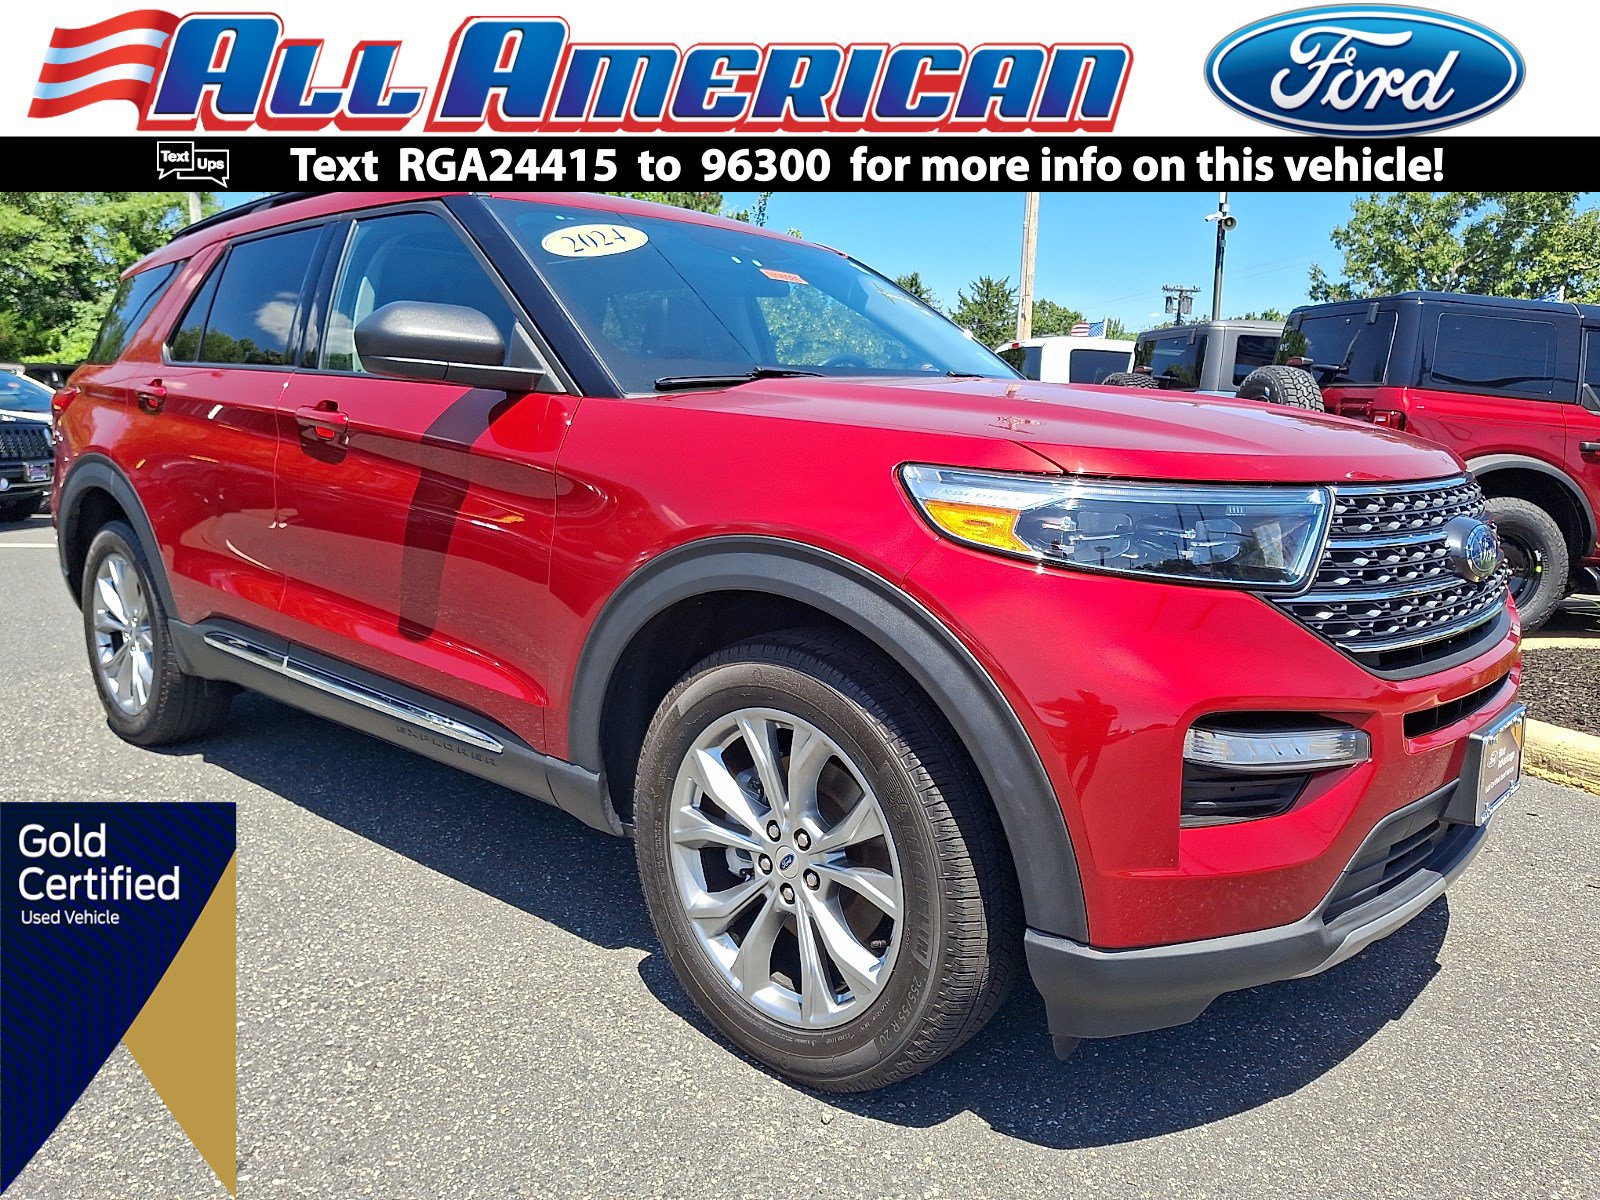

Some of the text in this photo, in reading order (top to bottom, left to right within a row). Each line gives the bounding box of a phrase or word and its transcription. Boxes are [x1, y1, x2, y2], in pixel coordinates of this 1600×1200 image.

[560, 228, 627, 253] 2024
[396, 725, 497, 767] EXPLORER
[879, 1028, 892, 1046] 20
[890, 1020, 900, 1033] R
